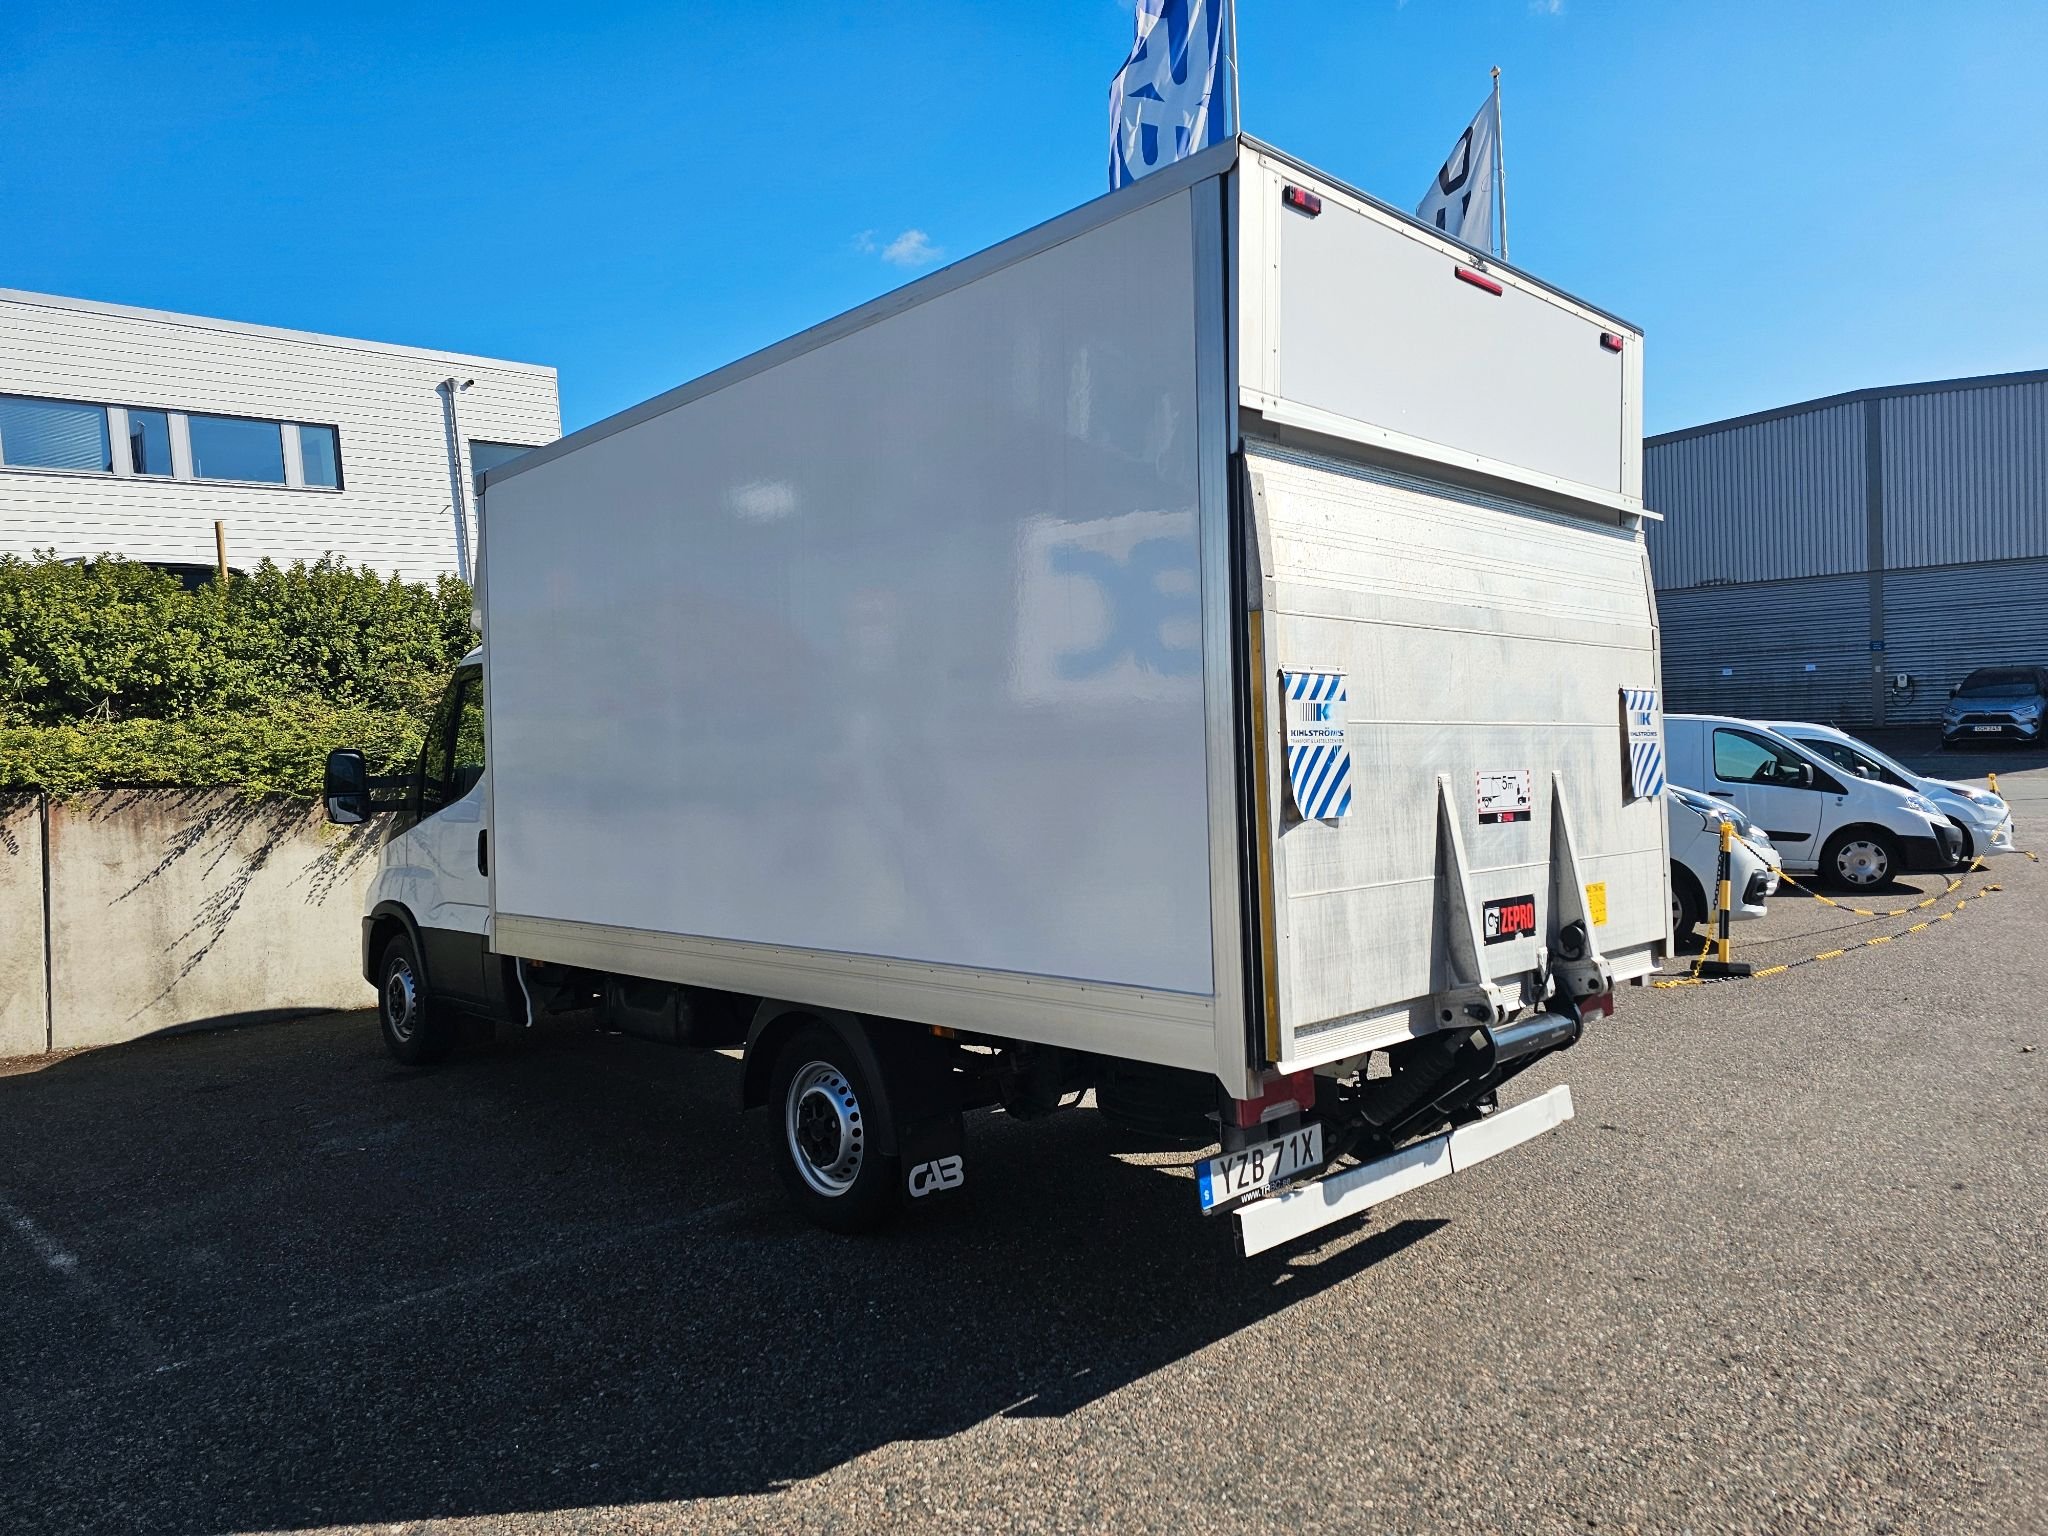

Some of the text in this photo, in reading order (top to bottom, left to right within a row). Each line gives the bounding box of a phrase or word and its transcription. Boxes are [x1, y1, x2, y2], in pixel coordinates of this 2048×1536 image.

[1500, 903, 1535, 934] ZEPRO
[908, 1154, 965, 1198] CAB
[1203, 1130, 1315, 1201] S YZB 71X
